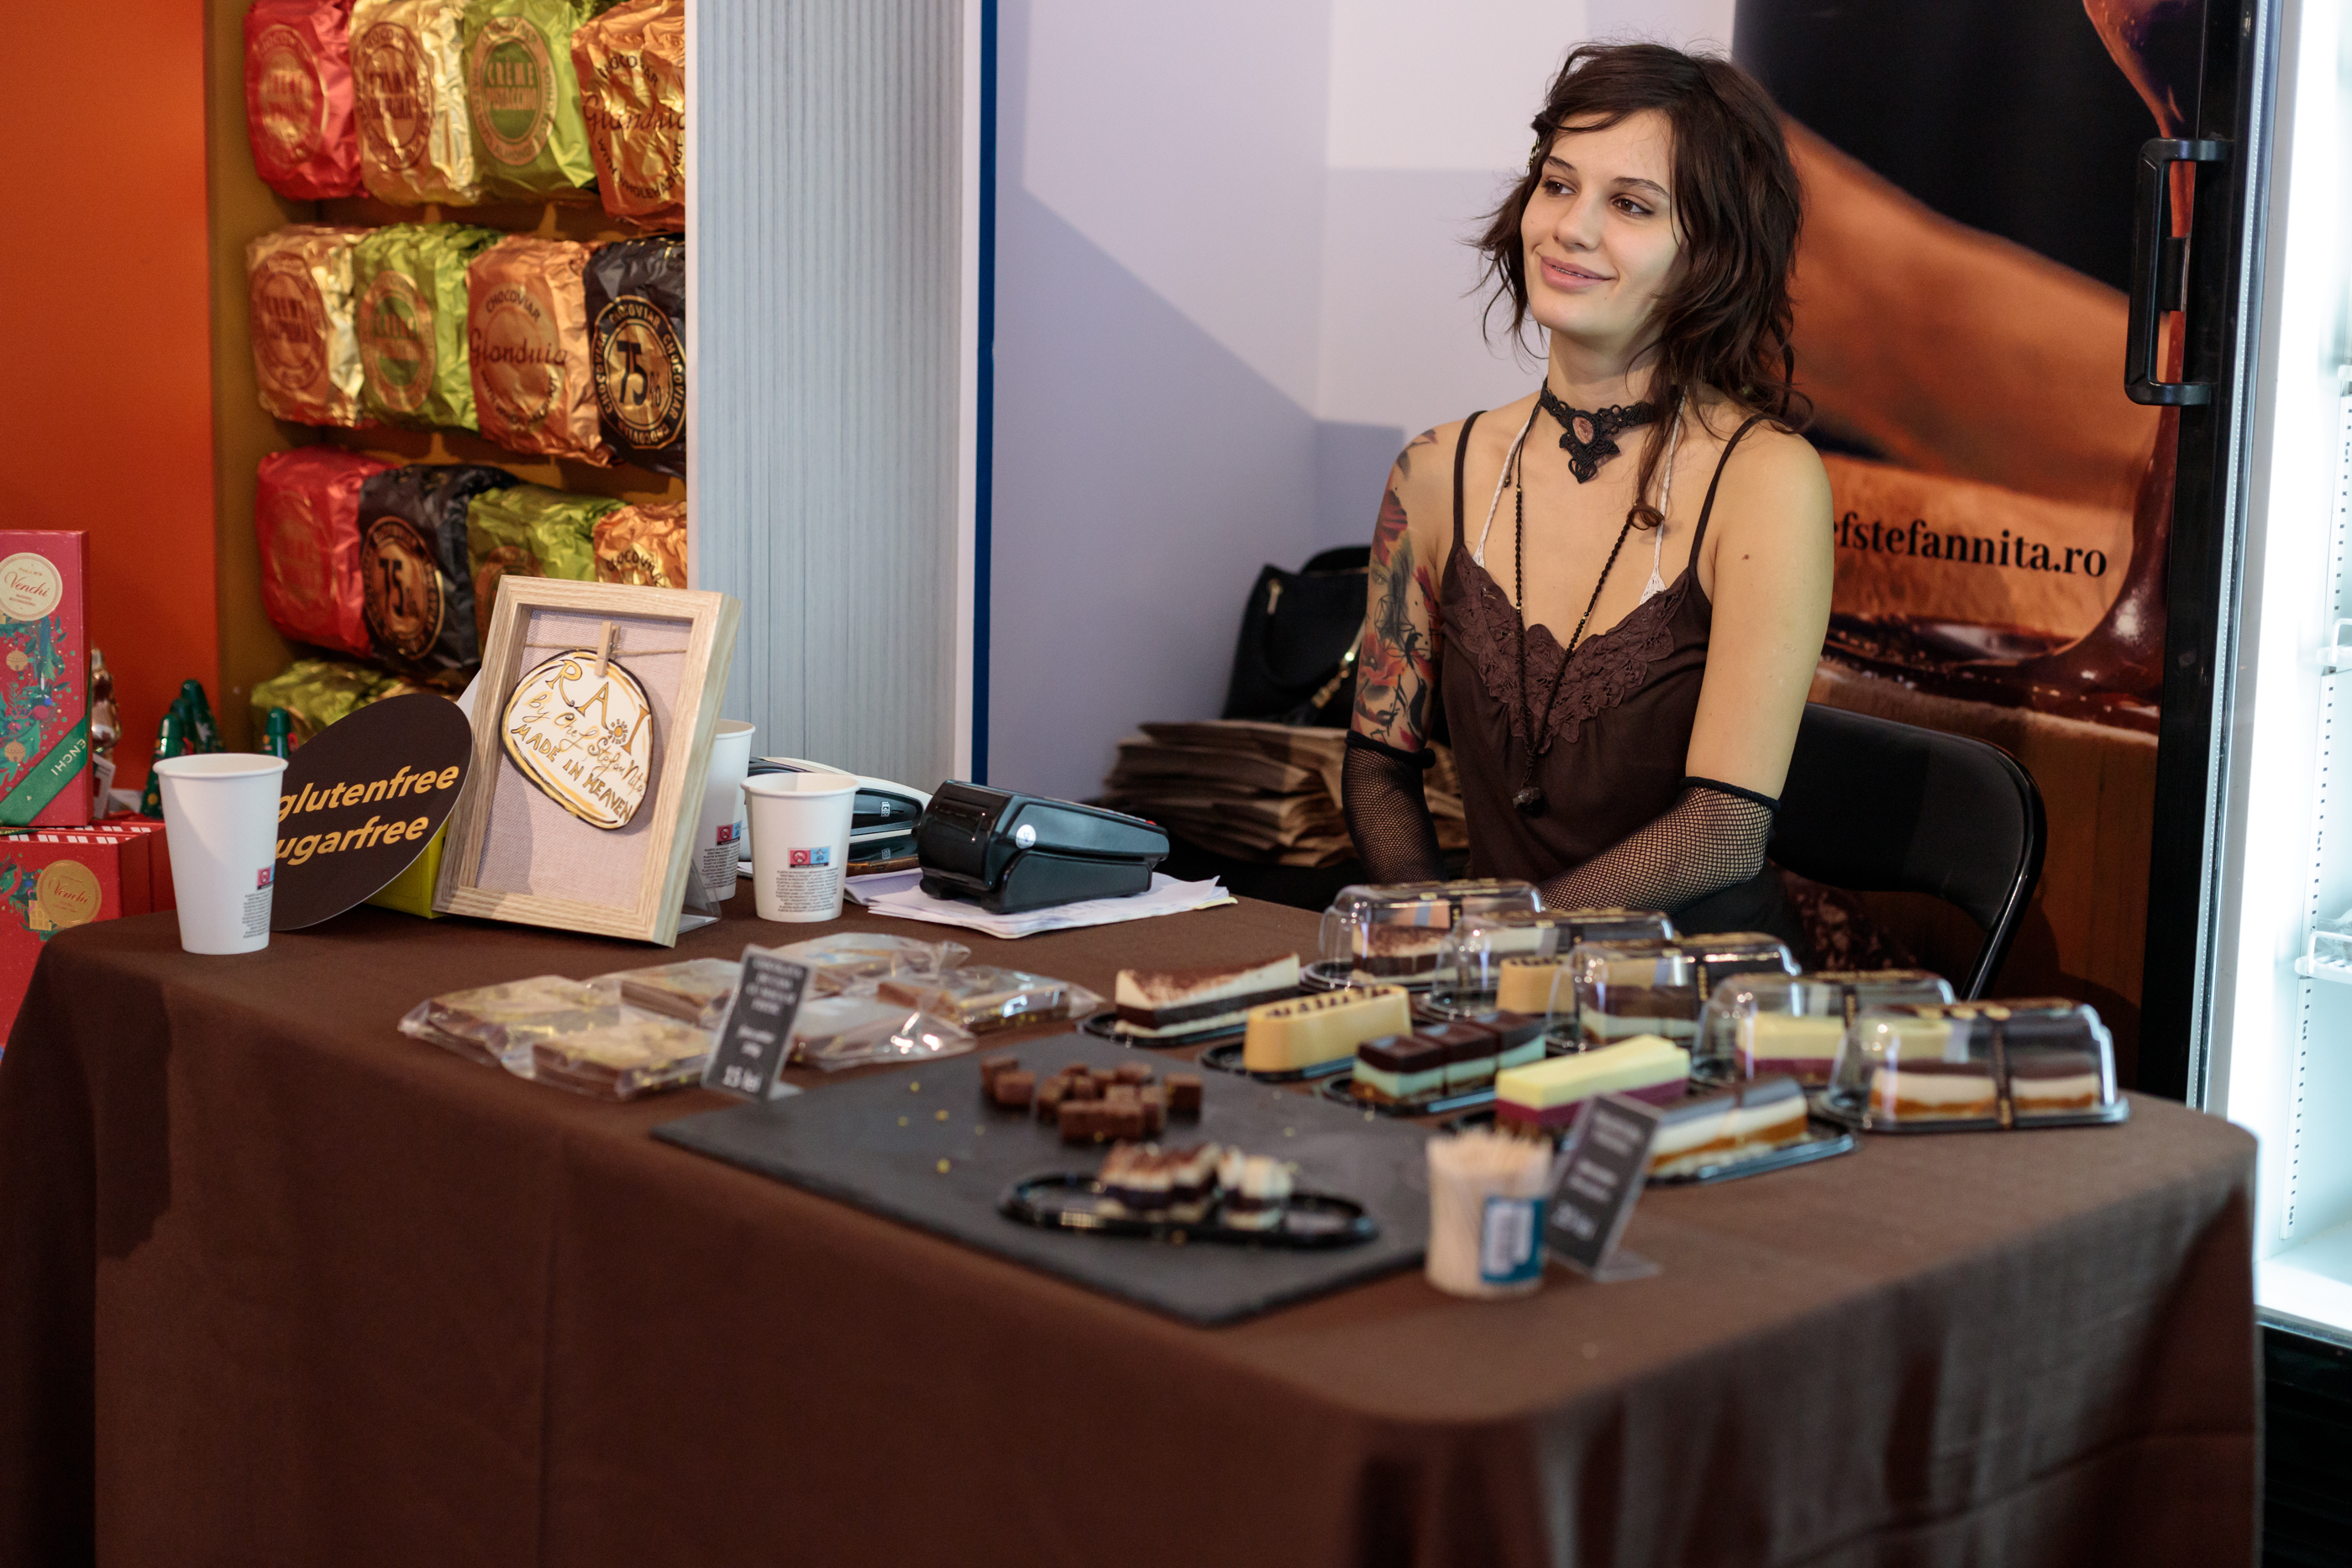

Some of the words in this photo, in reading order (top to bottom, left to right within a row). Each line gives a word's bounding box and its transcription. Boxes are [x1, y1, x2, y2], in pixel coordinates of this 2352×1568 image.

[486, 289, 541, 323] CHOCOVIAR
[469, 328, 568, 368] Gianduia
[663, 333, 685, 419] CHOCOVIAR
[1834, 511, 2108, 578] fstefannita.ro
[4, 571, 50, 597] Venchi
[50, 738, 87, 776] ENCHI
[511, 723, 560, 763] MADE
[563, 758, 585, 782] IN
[582, 773, 633, 824] HEAVEN
[278, 765, 459, 823] glutenfree
[276, 815, 429, 866] ugarfree
[48, 878, 90, 905] Venchi
